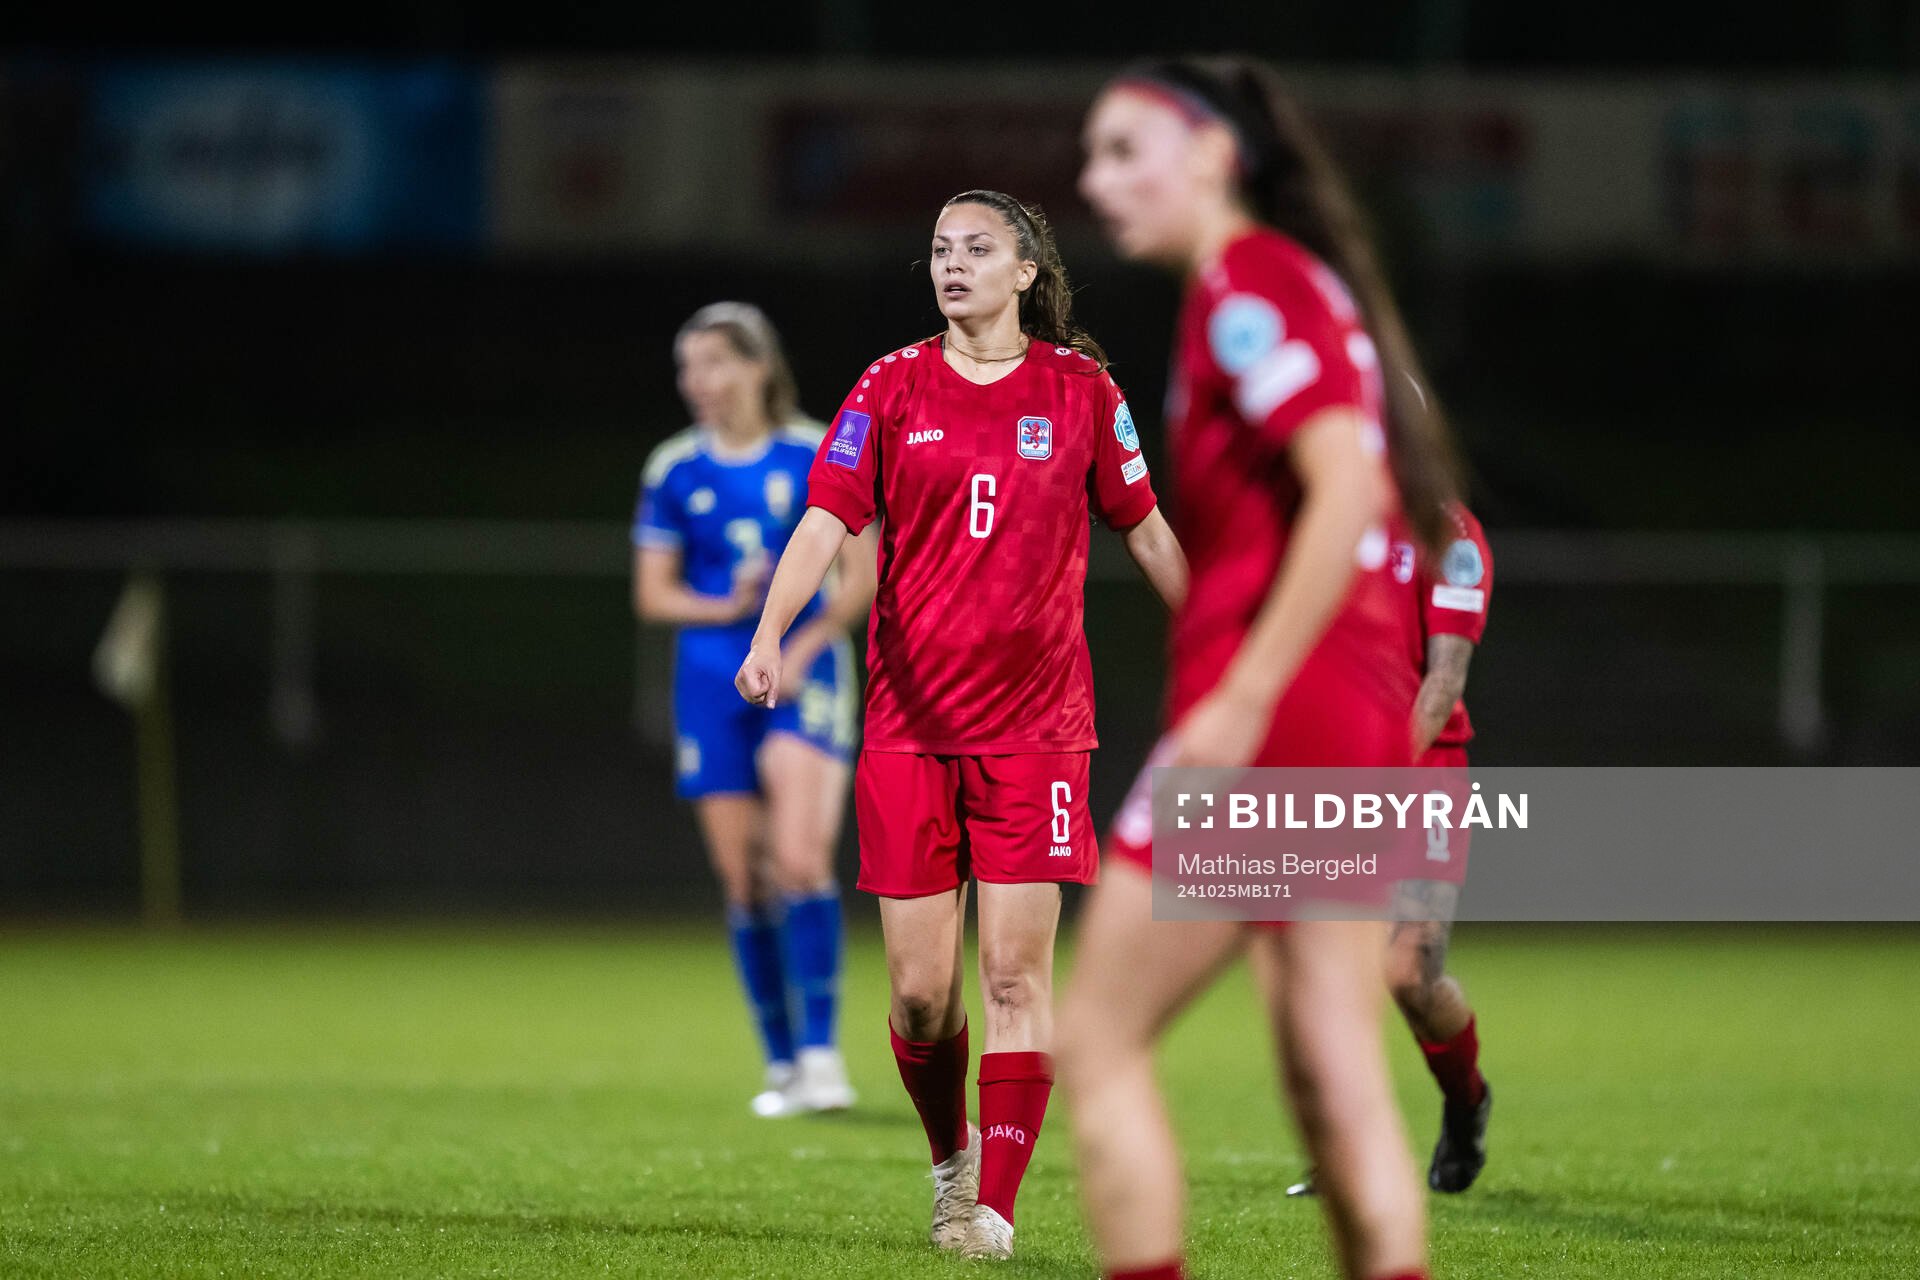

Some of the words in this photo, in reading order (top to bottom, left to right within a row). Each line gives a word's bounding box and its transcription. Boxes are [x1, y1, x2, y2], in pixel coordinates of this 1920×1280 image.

[906, 429, 944, 445] JAKO
[969, 474, 997, 539] 6
[1051, 781, 1072, 844] 6
[1048, 845, 1072, 857] JAKO
[986, 1124, 1025, 1145] JAKO
